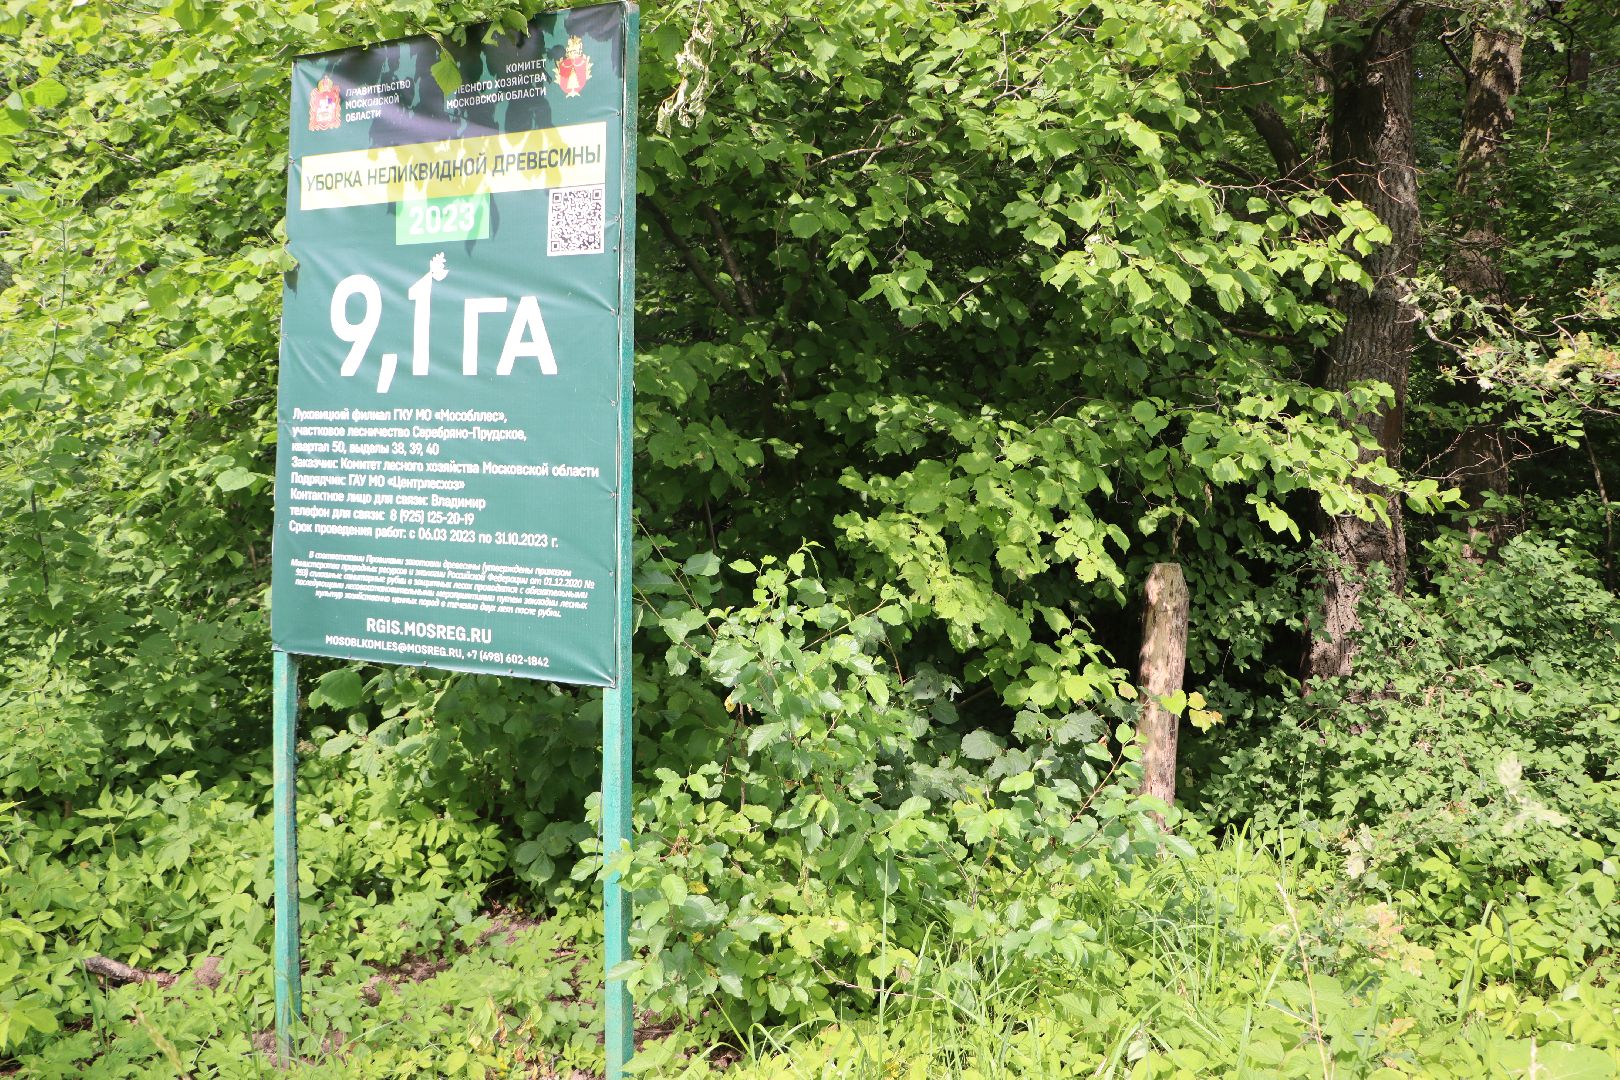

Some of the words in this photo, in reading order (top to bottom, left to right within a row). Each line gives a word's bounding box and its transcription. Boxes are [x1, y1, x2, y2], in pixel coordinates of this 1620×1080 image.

[505, 59, 547, 73] КОМИТЕТ
[345, 80, 411, 97] ПРАВИТЕЛЬСТВО
[494, 72, 547, 88] ХОЗЯЙСТВА
[345, 93, 400, 109] МОСКОВСКОЙ
[446, 91, 503, 109] МОСКОВСКОЙ
[505, 86, 547, 101] ОБЛАСТИ
[345, 109, 382, 123] ОБЛАСТИ
[306, 168, 362, 192] УБОРКА
[367, 152, 488, 185] НЕЛИКВИДНОЙ
[491, 144, 601, 176] ДРЕВЕСИНЫ
[408, 203, 476, 236] 2023
[330, 271, 434, 394] 9,1
[462, 295, 558, 376] ГА
[293, 408, 350, 421] Луховицкий
[351, 408, 391, 422] филиал
[394, 409, 413, 420] ГКУ
[416, 409, 432, 421] МО
[434, 409, 507, 423] «Мособллес»,
[292, 426, 345, 437] участковое
[347, 427, 410, 437] лесничество
[413, 426, 527, 441] Серебряно-Прудское,
[292, 441, 329, 454] квартал
[331, 441, 347, 454] 50,
[349, 443, 390, 455] выделы
[391, 442, 406, 456] 38,
[409, 443, 424, 456] 39,
[426, 443, 439, 455] 40
[291, 456, 338, 469] Заказчик:
[340, 457, 382, 470] Комитет
[383, 461, 423, 472] лесного
[426, 460, 479, 473] хозяйства
[482, 461, 549, 476] Московской
[552, 464, 599, 477] области
[291, 472, 346, 486] Подрядчик:
[348, 474, 366, 486] ГАУ
[368, 475, 385, 487] МО
[387, 476, 466, 491] «Центрлесхоз»
[290, 487, 344, 501] Контактное
[346, 493, 372, 504] лицо
[374, 494, 393, 505] для
[396, 495, 429, 506] связи:
[431, 494, 486, 511] Владимир
[289, 505, 330, 519] телефон
[332, 508, 351, 519] для
[353, 509, 386, 521] связи:
[390, 509, 397, 521] 8
[400, 509, 425, 524] (925)
[427, 511, 475, 525] 125-20-19
[289, 520, 312, 534] Срок
[315, 523, 372, 537] проведения
[375, 525, 407, 539] работ:
[409, 529, 416, 539] с
[418, 528, 447, 541] 06.03
[450, 529, 476, 543] 2023
[478, 533, 493, 544] по
[495, 532, 549, 547] 31.10.2023
[551, 537, 559, 548] г.
[291, 559, 340, 570] Министерства
[341, 563, 378, 573] природных
[447, 569, 486, 581] Российской
[487, 573, 529, 585] Федерации
[529, 577, 542, 586] от
[543, 577, 583, 588] 01.12.2020
[584, 580, 595, 589] №
[442, 559, 481, 570] древесины
[535, 567, 572, 577] приказом
[524, 586, 588, 599] обязательными
[559, 601, 588, 610] лесных
[366, 617, 492, 644] RGIS.MOSREG.RU
[325, 634, 465, 659] MOSOBLKOMLES@MOSREG.RU,
[466, 650, 478, 660] +7
[479, 650, 504, 664] (498)
[505, 654, 550, 668] 602-1842
